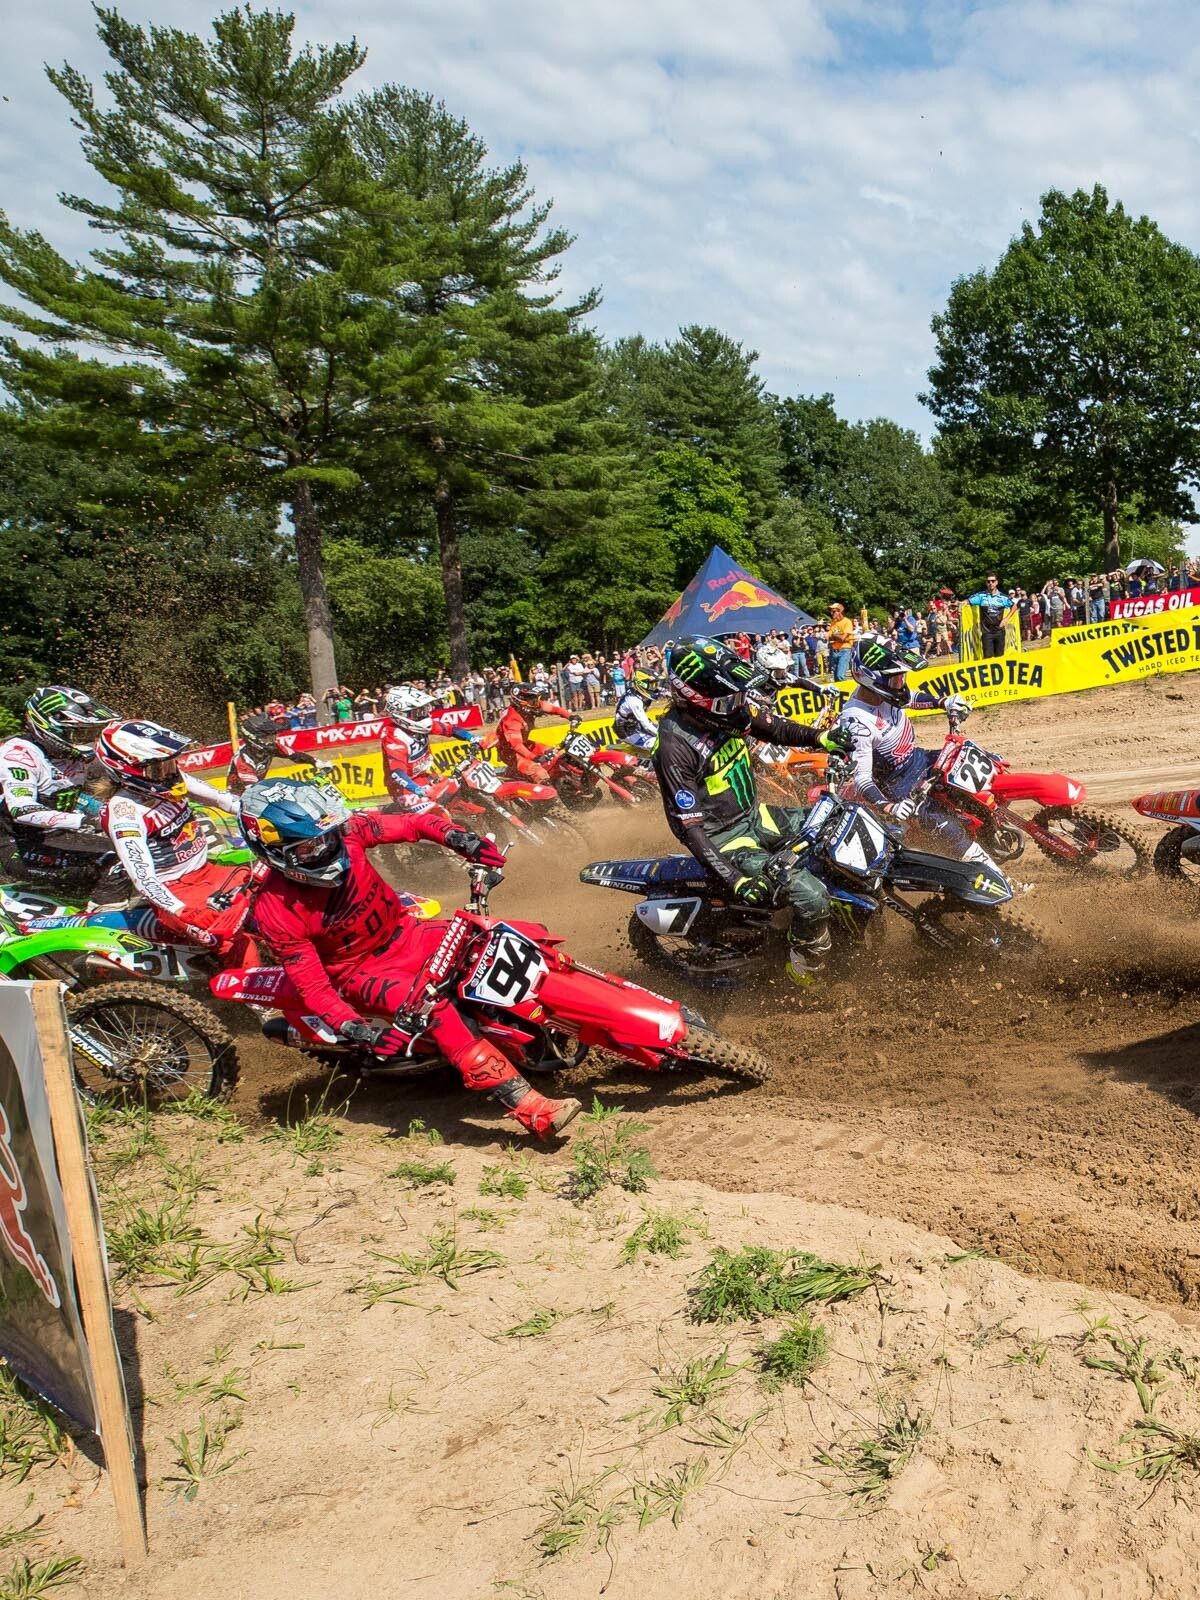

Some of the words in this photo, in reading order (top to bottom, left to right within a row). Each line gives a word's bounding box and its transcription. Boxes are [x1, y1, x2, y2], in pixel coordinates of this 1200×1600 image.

[1113, 597, 1165, 620] LUCAS
[1168, 592, 1194, 611] OIL
[1101, 628, 1190, 674] TWISTED
[1139, 661, 1163, 673] HARD
[1166, 655, 1187, 666] ICED
[918, 663, 1005, 698] TWISTED
[1006, 660, 1043, 688] TEA
[316, 722, 384, 745] MX-ATV
[572, 736, 592, 758] 391
[343, 763, 374, 788] TEA
[470, 762, 497, 790] 270
[960, 749, 993, 792] 23
[1148, 811, 1180, 821] DUNLOP
[175, 838, 199, 863] Red
[600, 879, 641, 892] DUNLOP
[665, 901, 698, 934] 7
[429, 916, 463, 974] RENTHAL
[487, 943, 497, 957] OIL
[486, 936, 542, 1005] 94
[232, 991, 276, 1002] DUNLOP
